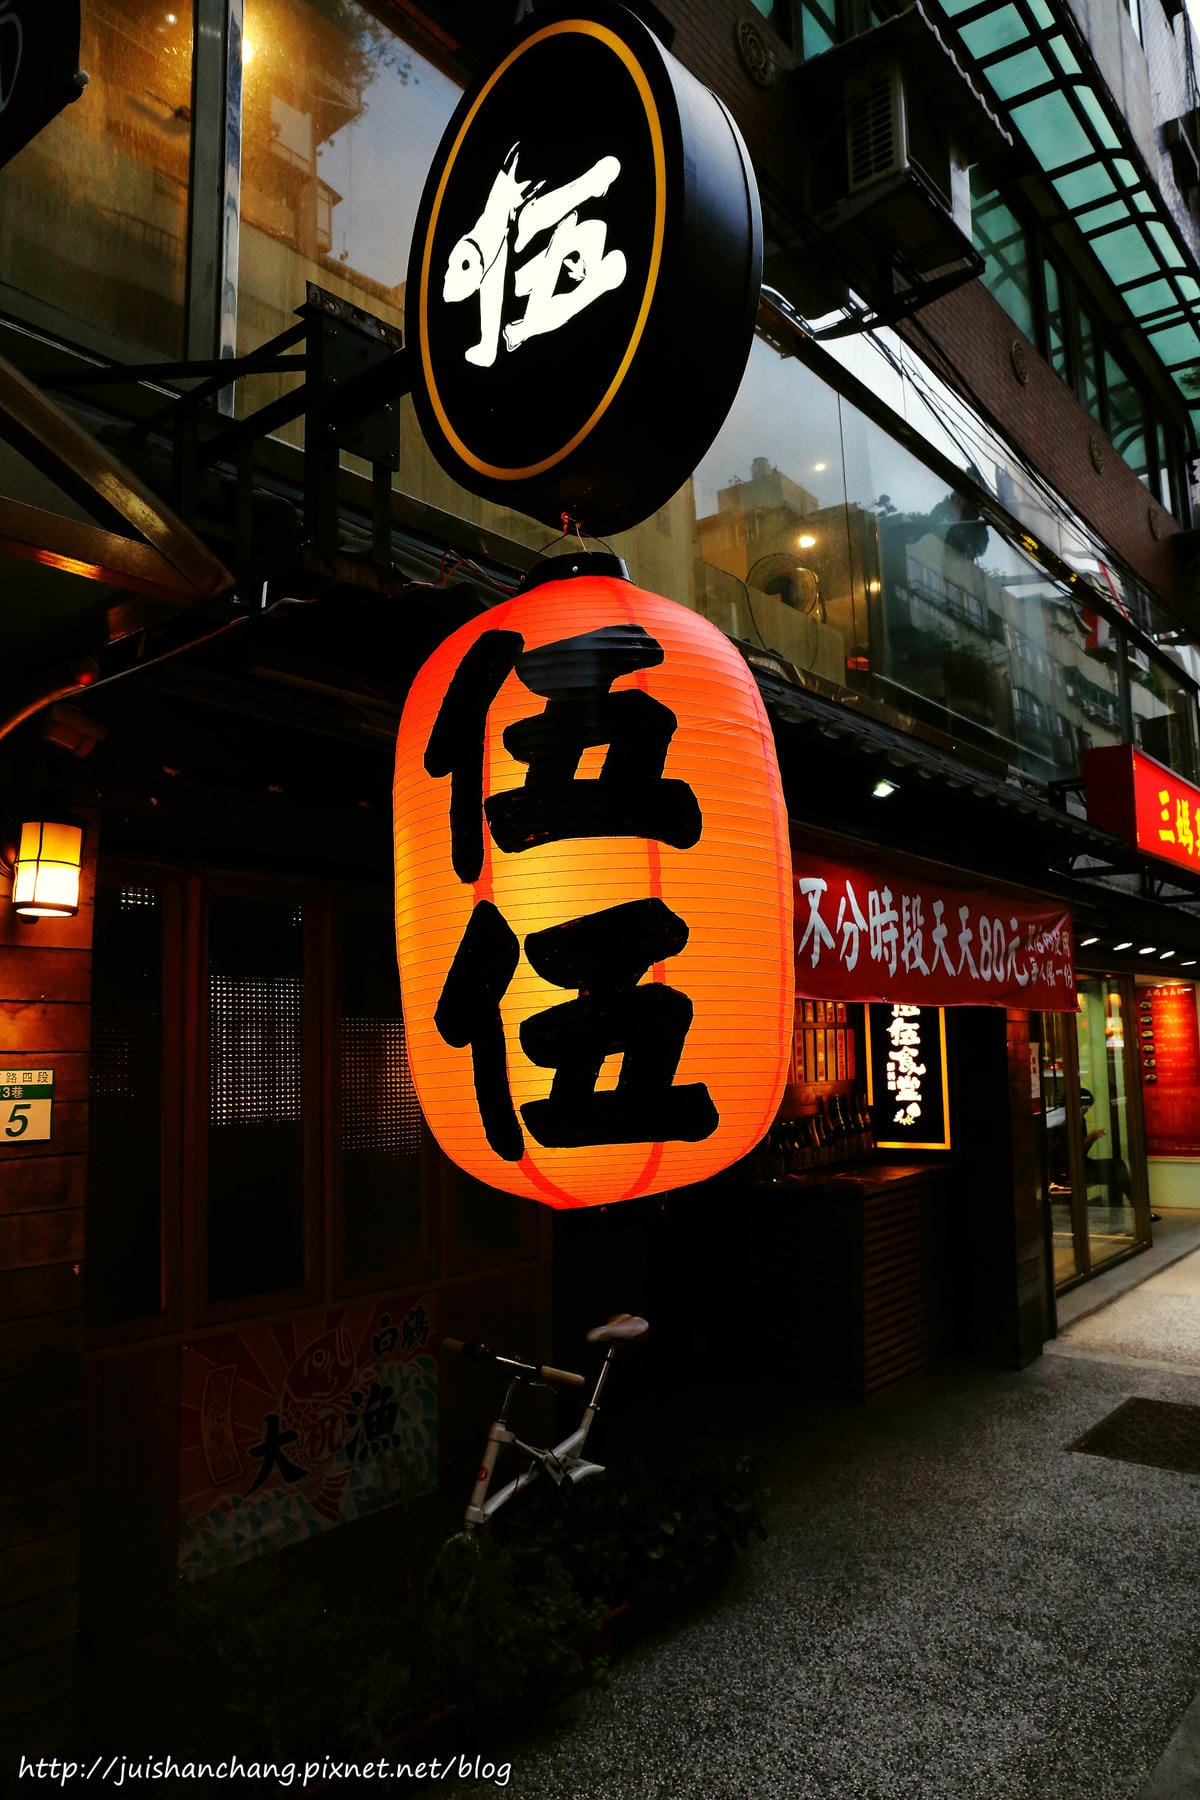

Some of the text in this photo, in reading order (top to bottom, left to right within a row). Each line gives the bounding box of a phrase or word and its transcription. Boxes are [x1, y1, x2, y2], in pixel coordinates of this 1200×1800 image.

[424, 624, 720, 1161] 伍伍
[799, 878, 1028, 987] 不分時段天天80元
[0, 1071, 49, 1083] 路四段
[5, 1103, 32, 1138] 5
